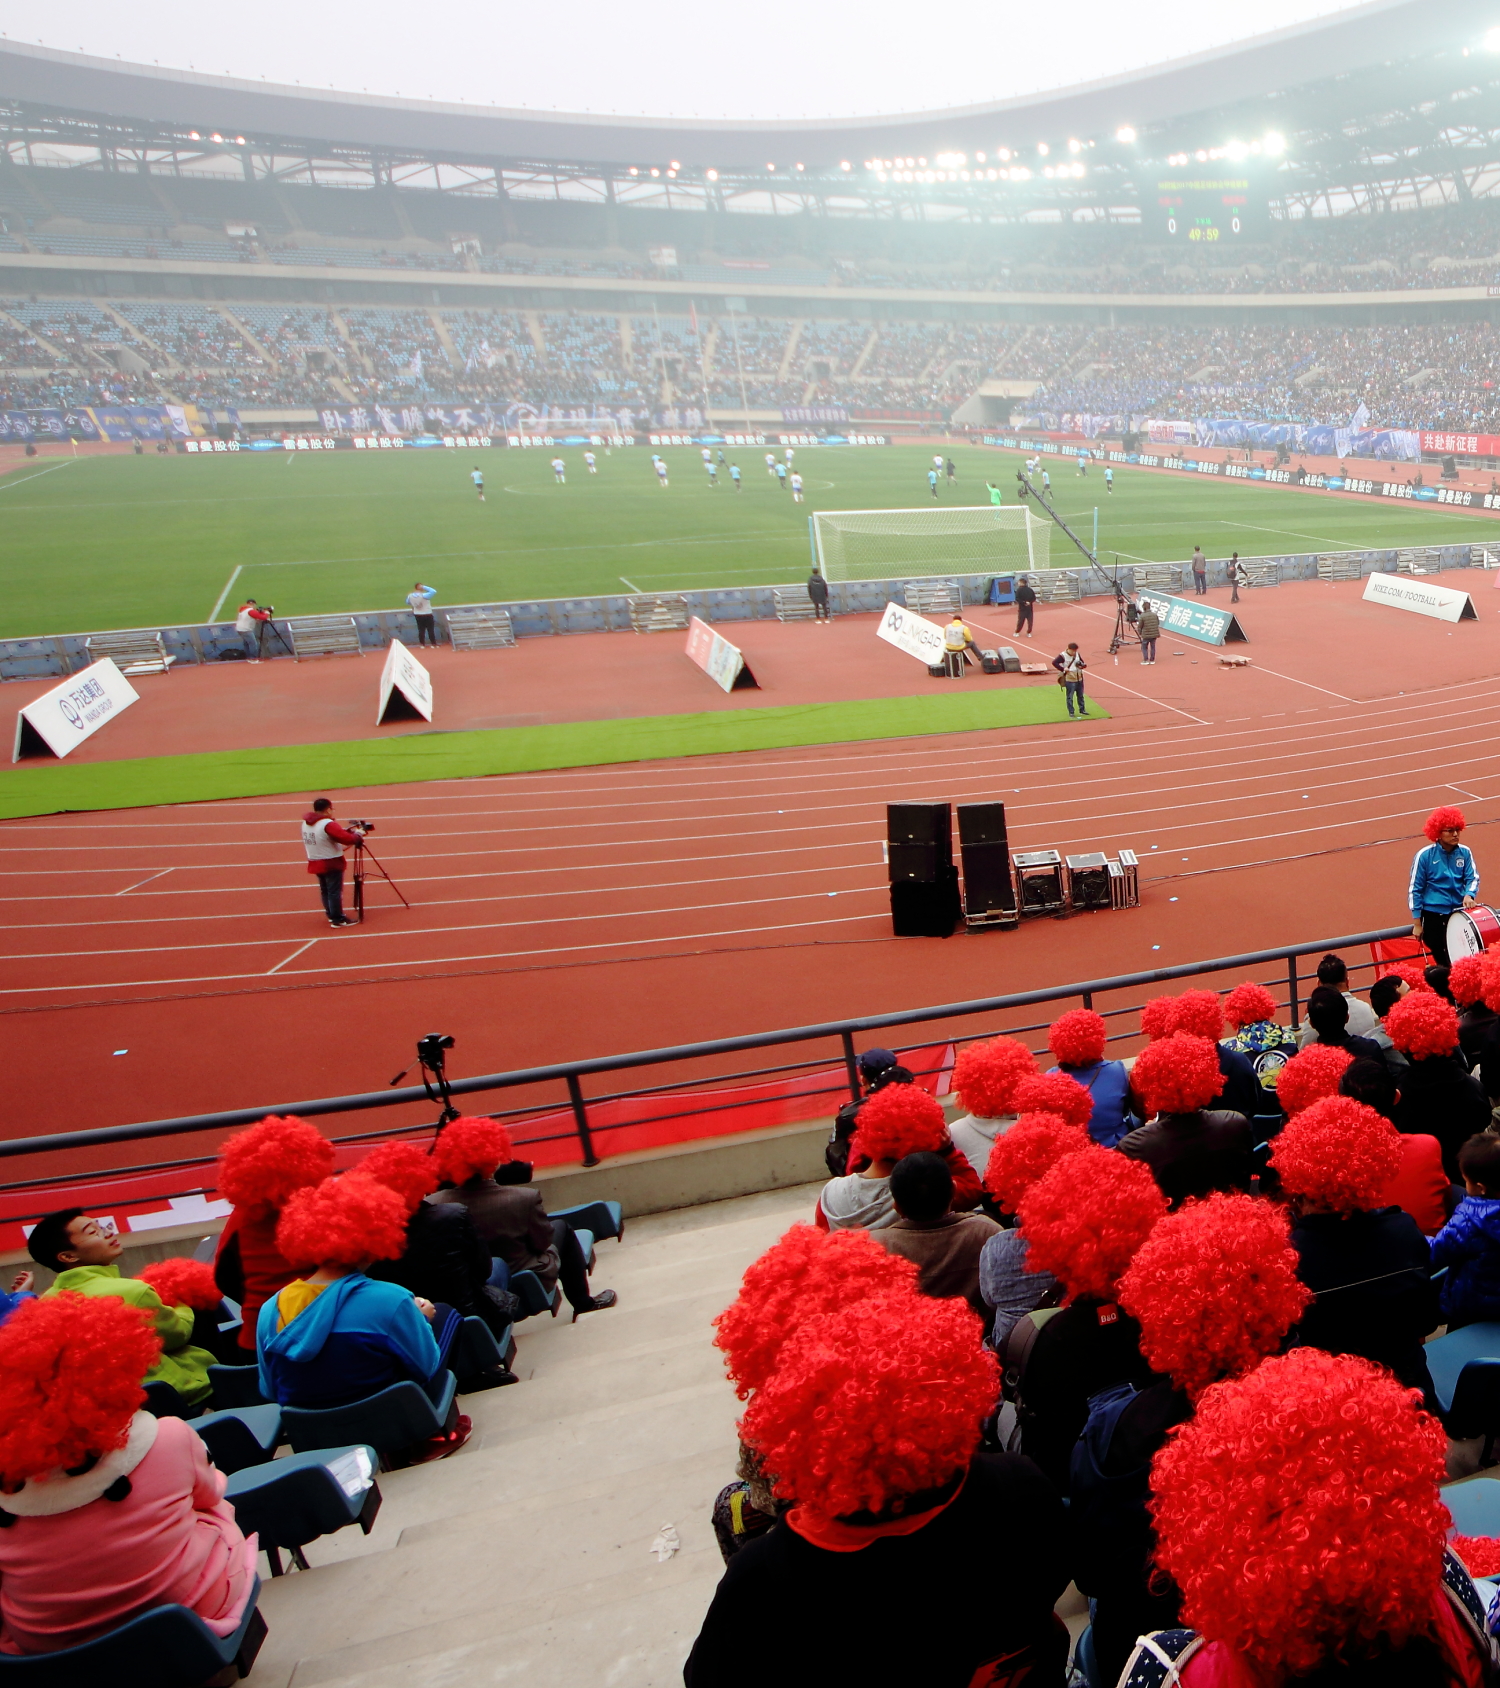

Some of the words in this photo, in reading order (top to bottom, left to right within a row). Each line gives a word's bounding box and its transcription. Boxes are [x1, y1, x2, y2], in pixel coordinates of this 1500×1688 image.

[1189, 228, 1219, 241] 49:59
[185, 440, 241, 452] 雷曼股份
[284, 438, 336, 450] 雷曼股份
[353, 437, 404, 449] 雷曼股份
[443, 436, 492, 448] 雷曼股份
[1424, 433, 1478, 453] 共赴新征程
[1265, 469, 1290, 483] 雷曼股份
[1344, 478, 1373, 494] 雷曼股份
[1382, 482, 1413, 499] 雷曼股份
[1437, 489, 1472, 506] 雷曼股份
[1373, 583, 1437, 606] NIKE.COM/FOOTBALL
[1168, 605, 1193, 628] 新房
[1190, 612, 1225, 638] 二手房
[69, 678, 106, 711] 万达集团
